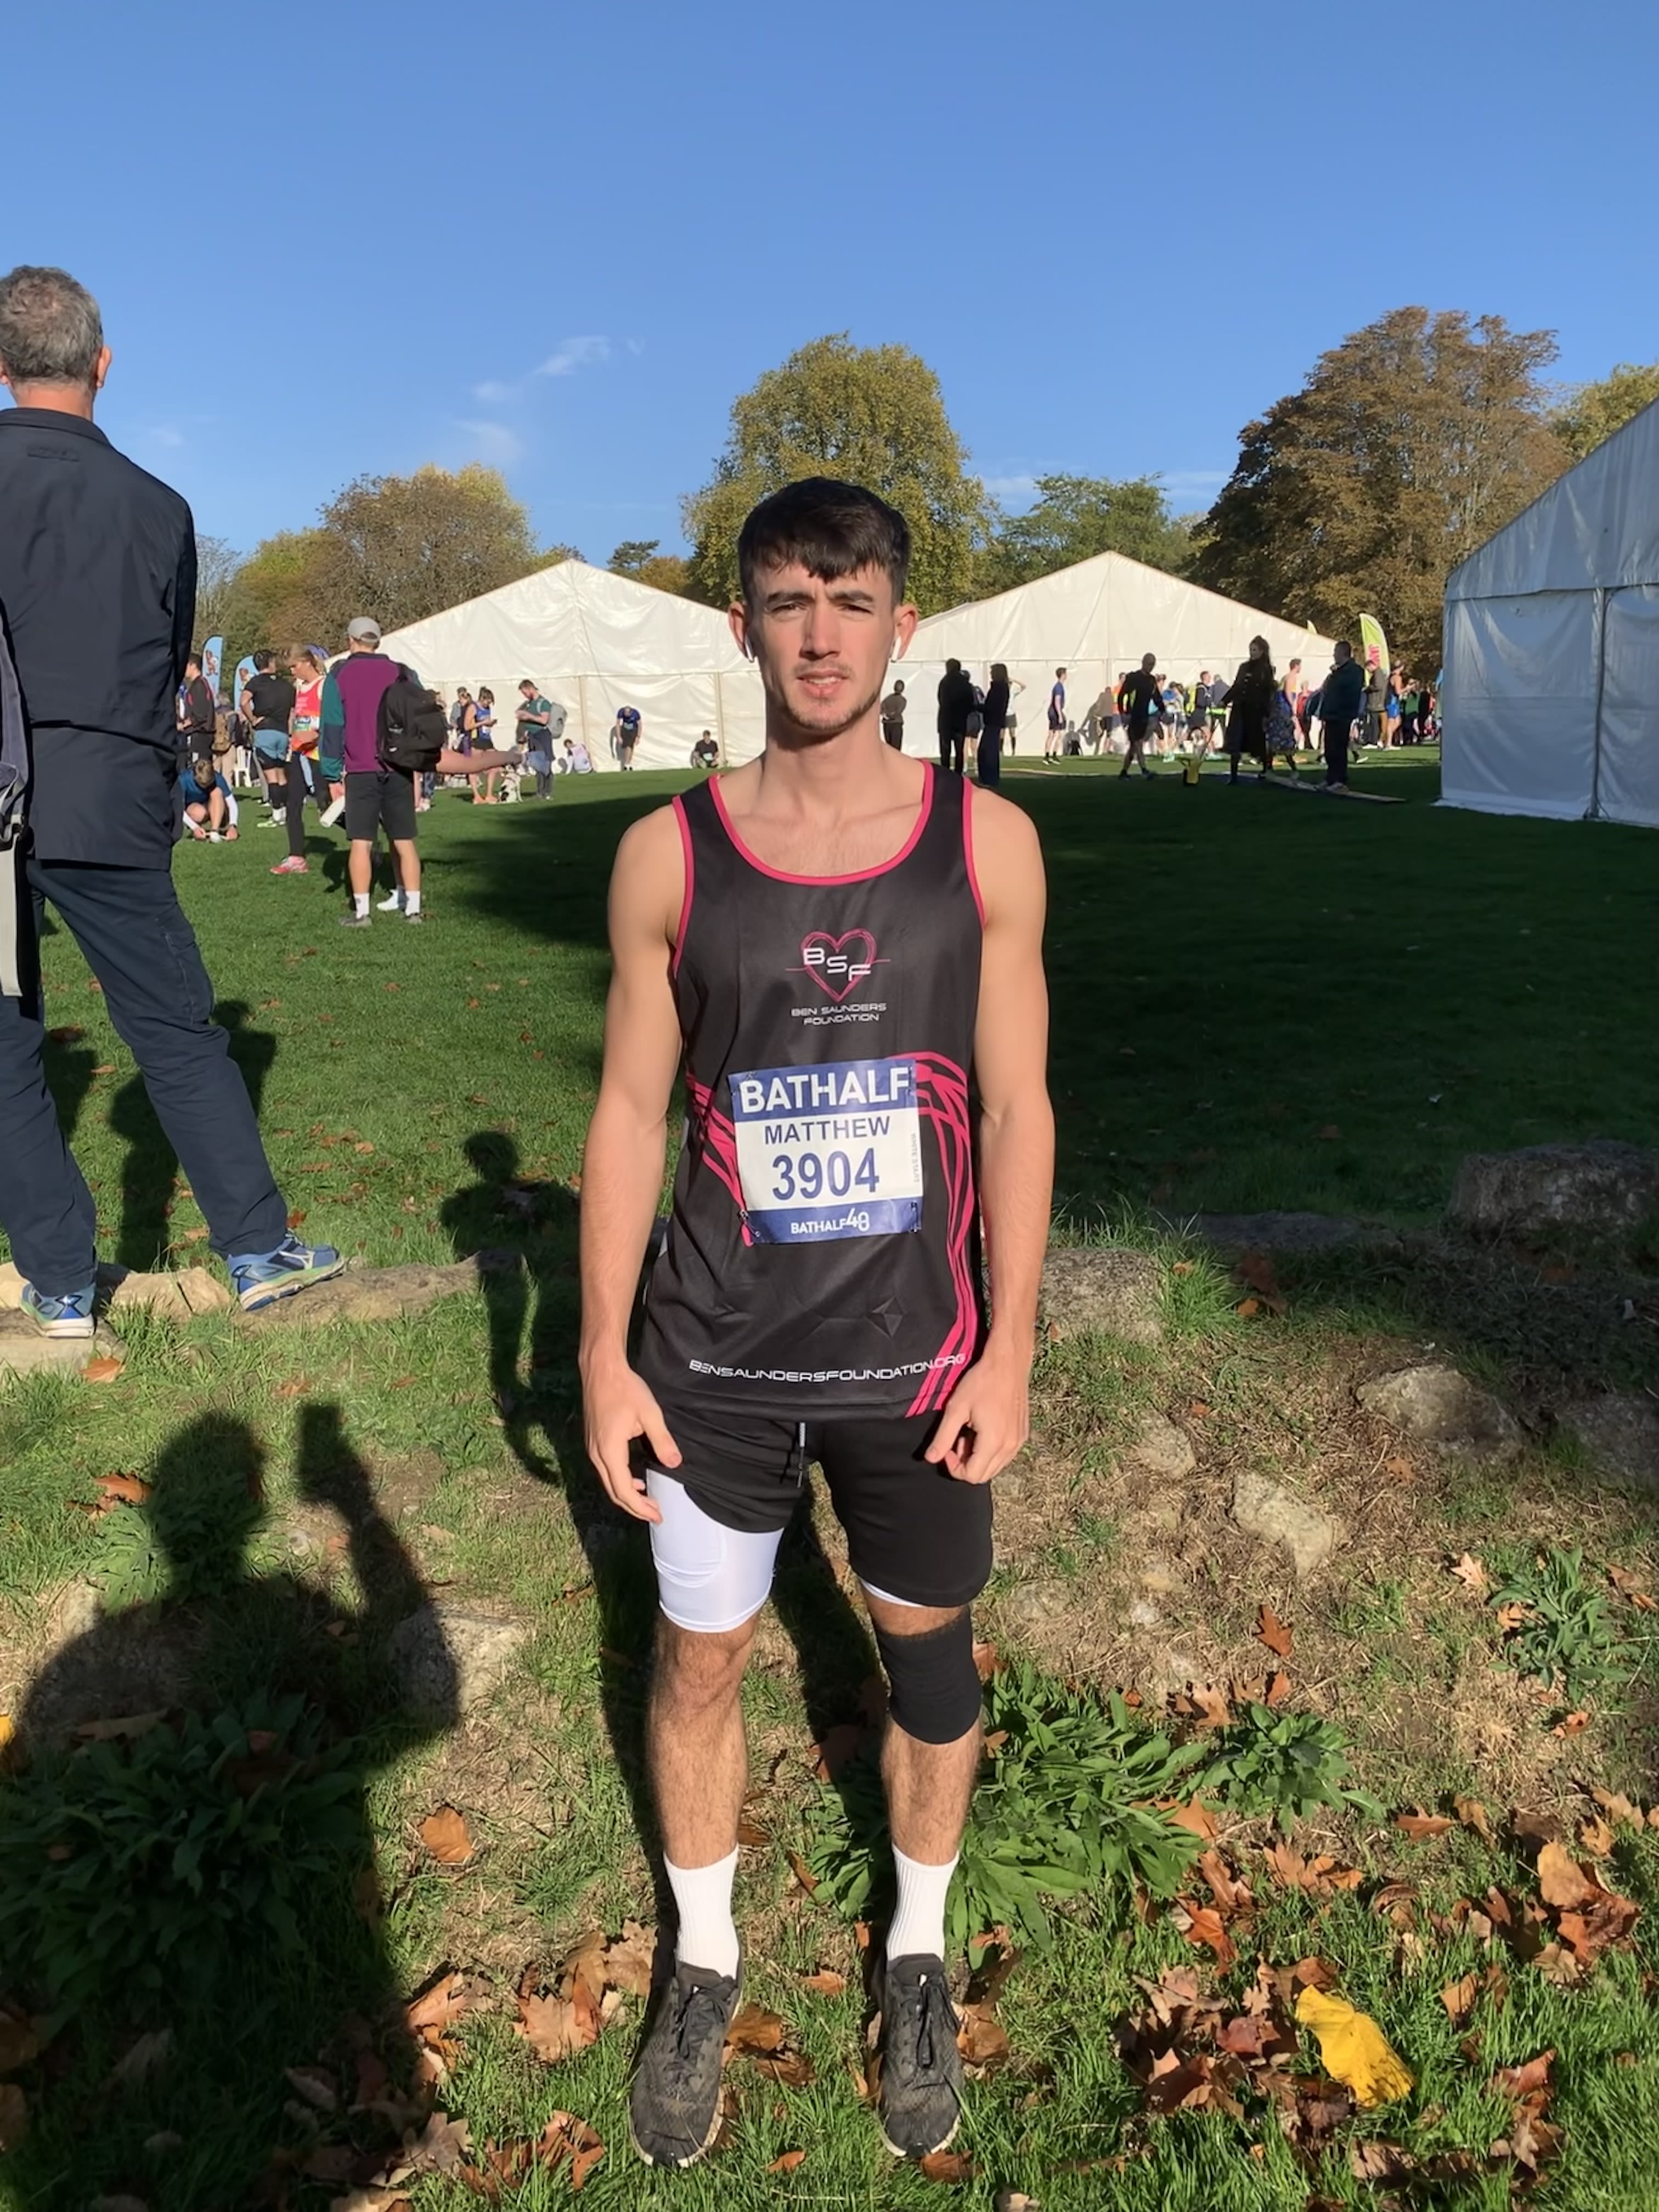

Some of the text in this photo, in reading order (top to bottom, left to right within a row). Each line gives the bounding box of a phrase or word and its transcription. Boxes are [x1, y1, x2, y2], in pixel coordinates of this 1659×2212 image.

[791, 1003, 887, 1017] BEN SAUNDERS
[804, 1014, 879, 1025] FOUNDATION
[739, 1066, 910, 1114] BATHALF
[765, 1116, 890, 1145] MATTHEW
[772, 1148, 879, 1200] 3904
[689, 1353, 966, 1383] BENSAUNDERSFOUNDATION.ORG
